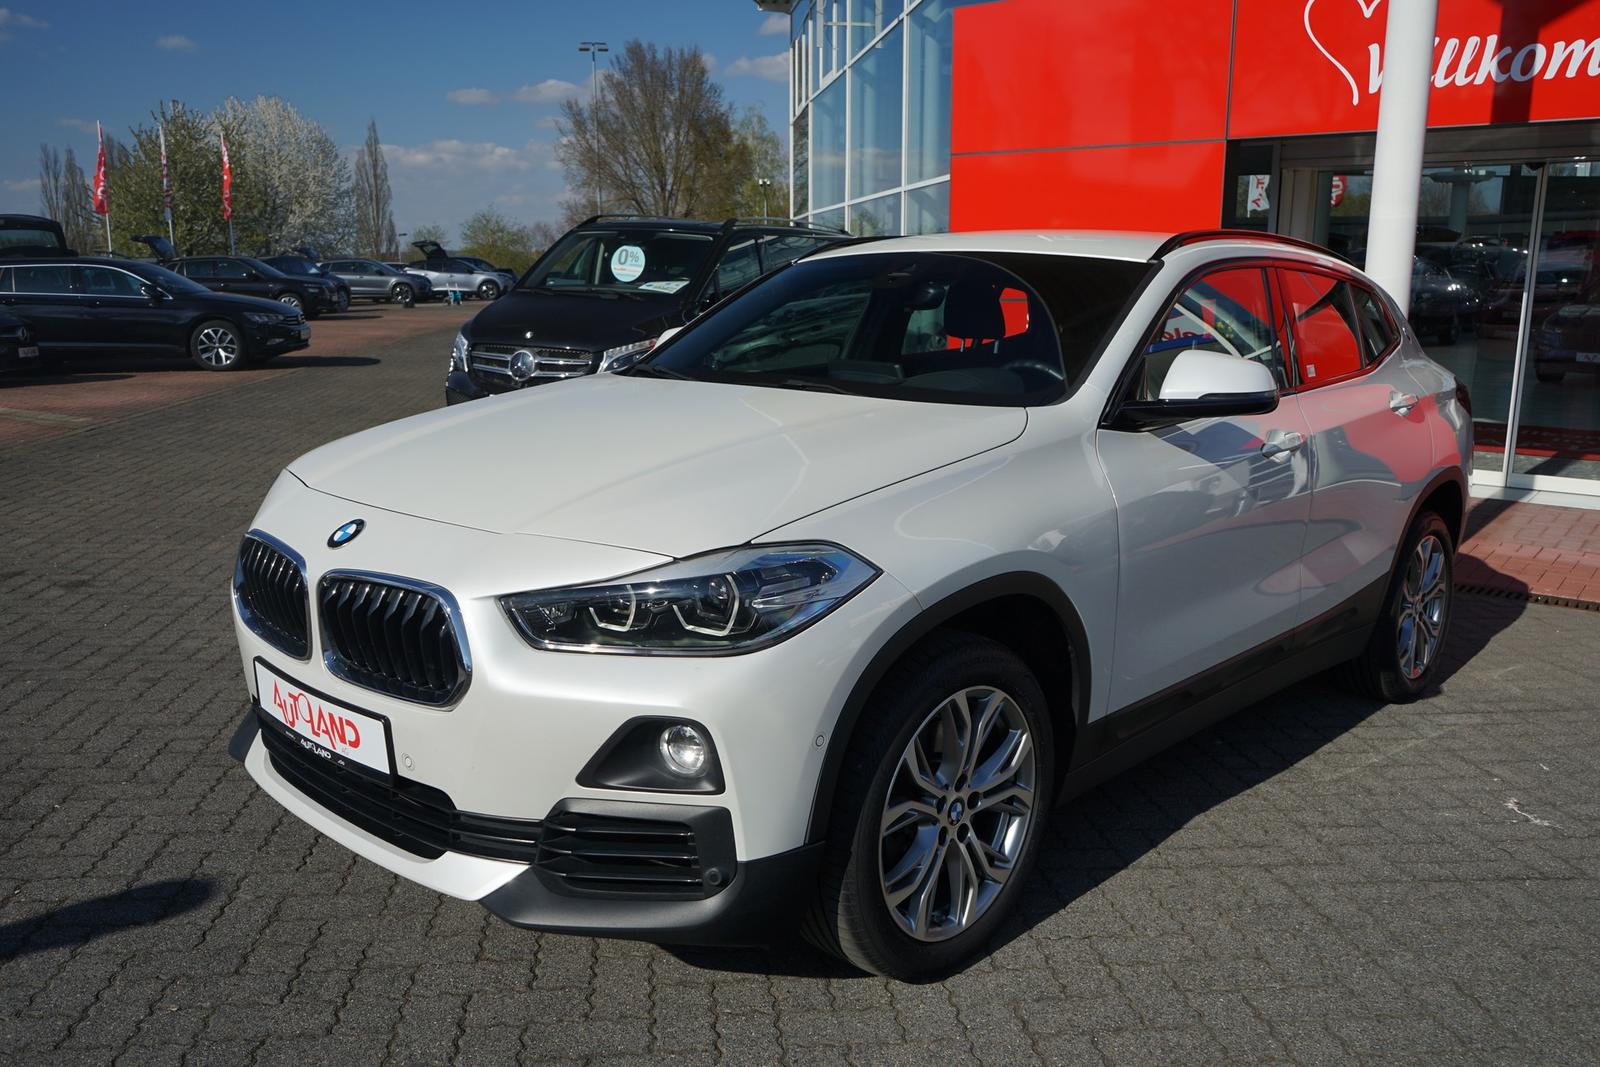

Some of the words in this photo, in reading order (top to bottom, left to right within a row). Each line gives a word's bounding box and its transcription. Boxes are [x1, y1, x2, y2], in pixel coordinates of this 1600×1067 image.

[1368, 34, 1600, 94] llkom
[618, 248, 640, 266] 0%
[273, 679, 361, 750] AUTOLAND
